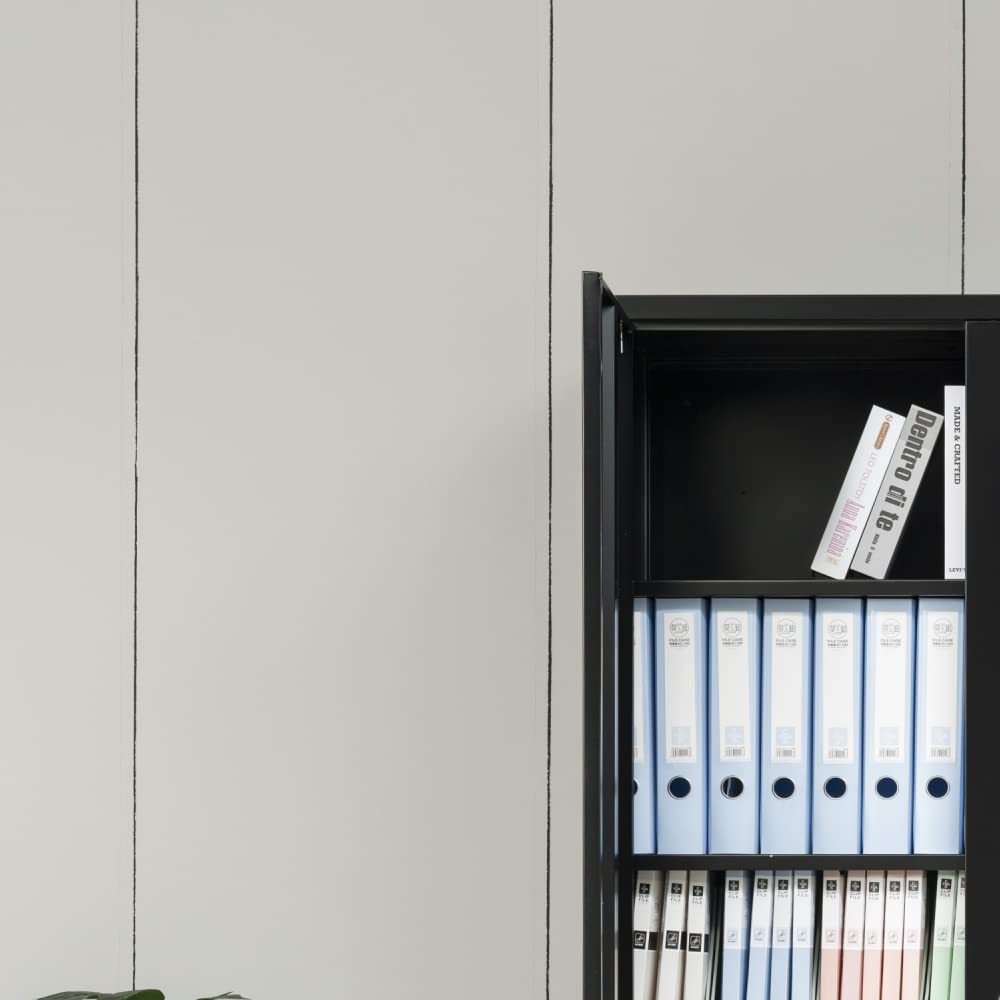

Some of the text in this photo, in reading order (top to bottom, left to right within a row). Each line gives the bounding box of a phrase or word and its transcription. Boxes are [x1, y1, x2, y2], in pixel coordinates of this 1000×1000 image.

[867, 452, 879, 468] LEO
[876, 410, 937, 531] Dentro di te
[953, 406, 961, 485] MADE & CRAFTED
[826, 499, 866, 557] Anna Karenina
